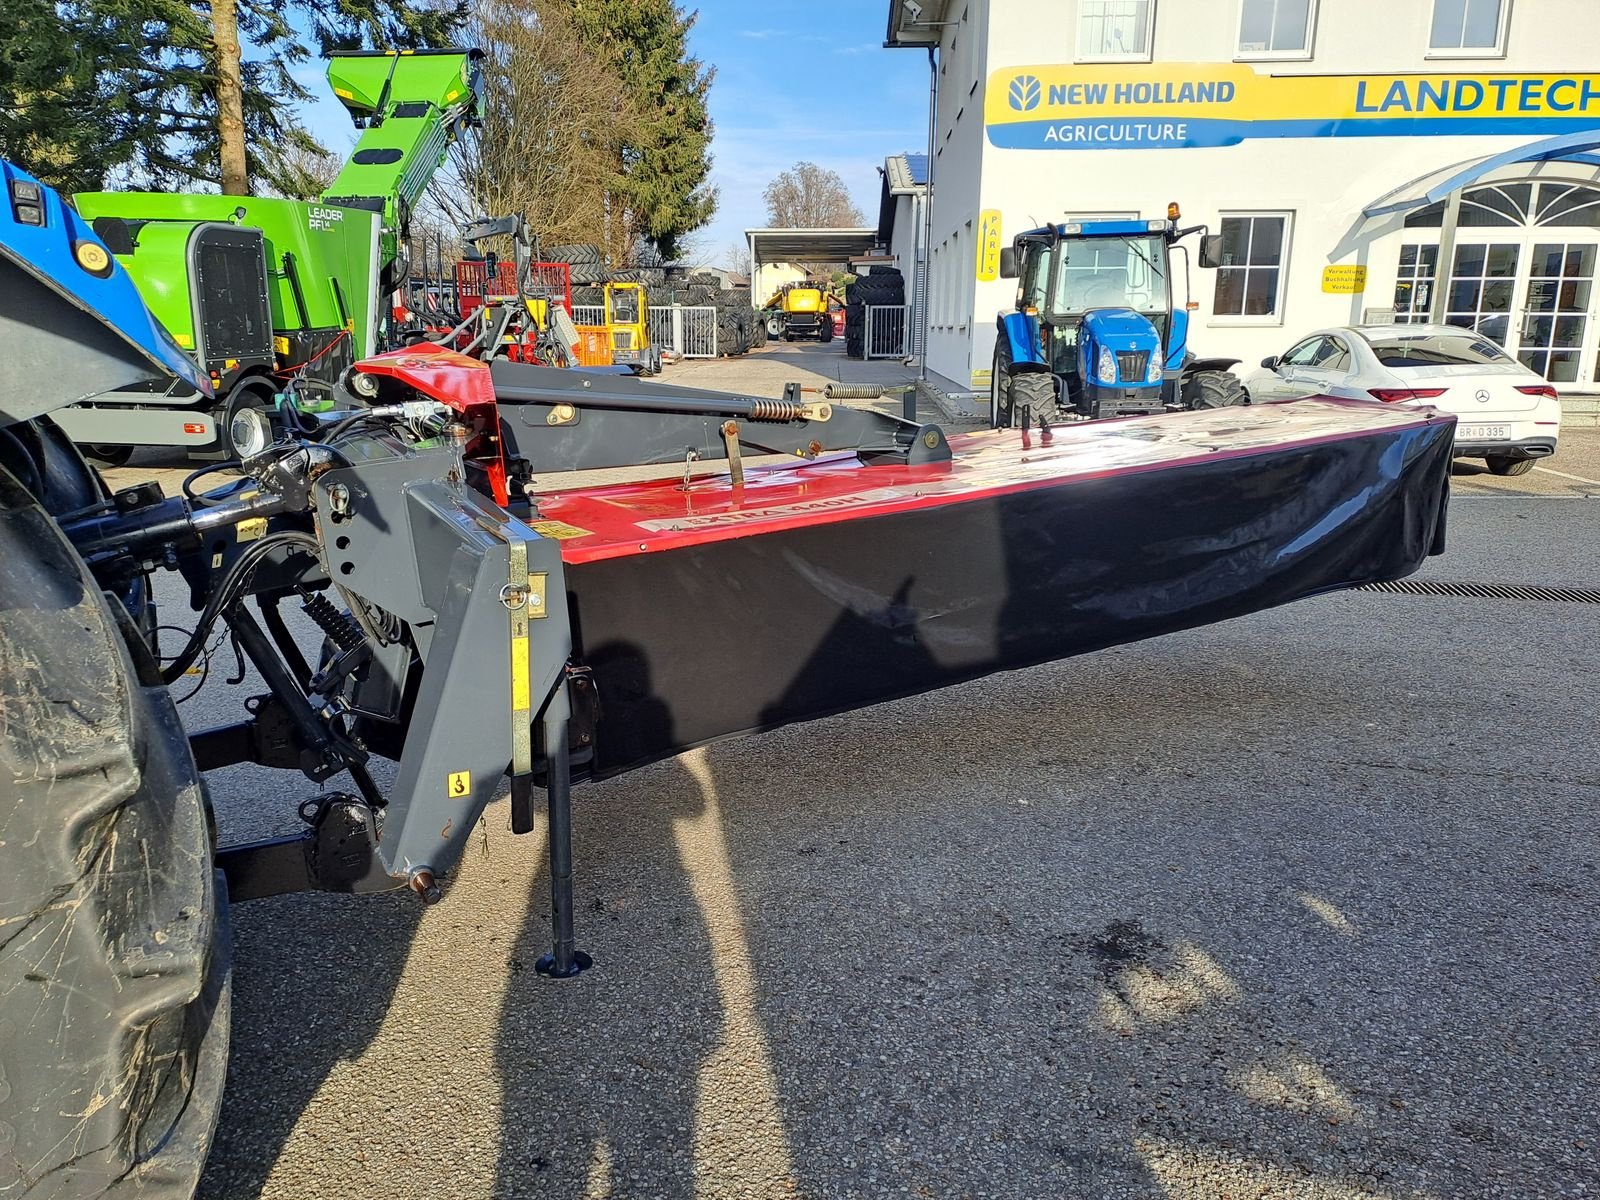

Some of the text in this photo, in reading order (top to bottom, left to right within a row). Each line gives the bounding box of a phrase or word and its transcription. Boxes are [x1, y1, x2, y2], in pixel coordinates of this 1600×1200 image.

[1048, 81, 1235, 105] NEW HOLLAND
[1355, 79, 1600, 112] LANDTECH
[1044, 123, 1187, 142] AGRICULTURE
[307, 206, 343, 221] LEADER
[988, 216, 997, 273] PARTS
[1460, 428, 1471, 437] BR
[1486, 427, 1504, 436] 335
[685, 496, 867, 525] EXTRA 440H
